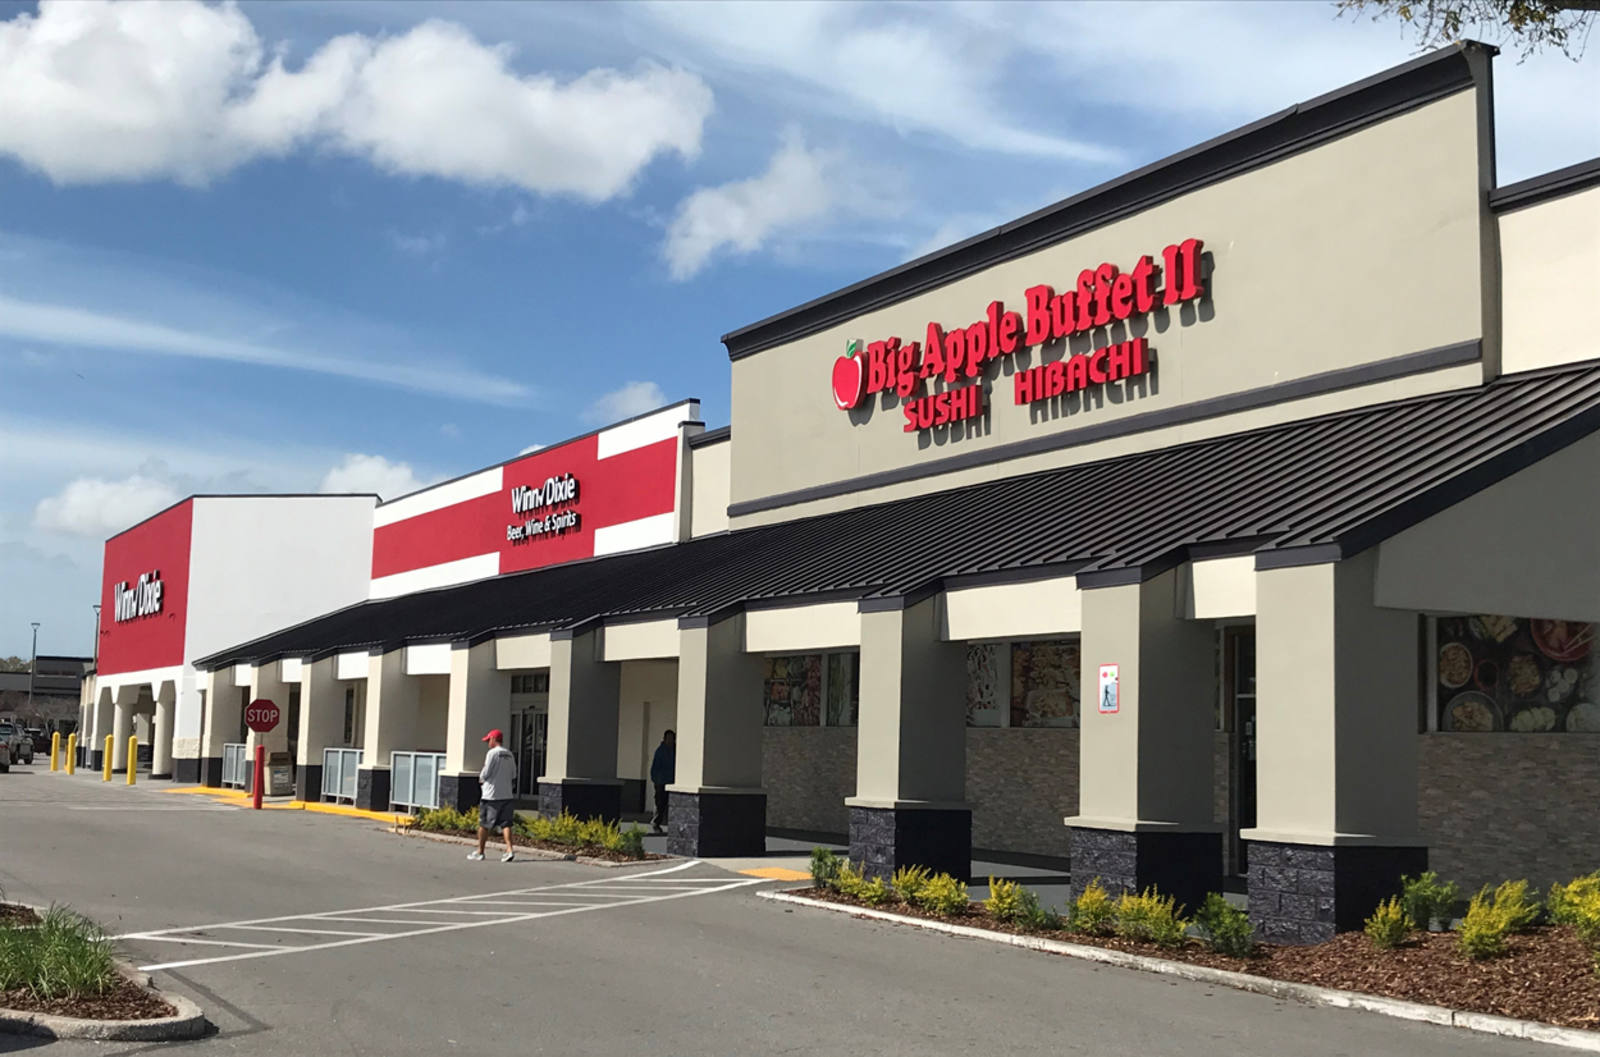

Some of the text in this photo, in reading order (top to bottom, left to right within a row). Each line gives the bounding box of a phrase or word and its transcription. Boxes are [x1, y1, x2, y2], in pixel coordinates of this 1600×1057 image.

[867, 238, 1204, 397] Big Apple Buffet II
[904, 337, 1149, 433] SUSHI HIBACHI
[525, 519, 543, 536] Wine
[544, 515, 552, 532] &
[552, 510, 577, 534] Spirits
[248, 709, 279, 722] STOP
